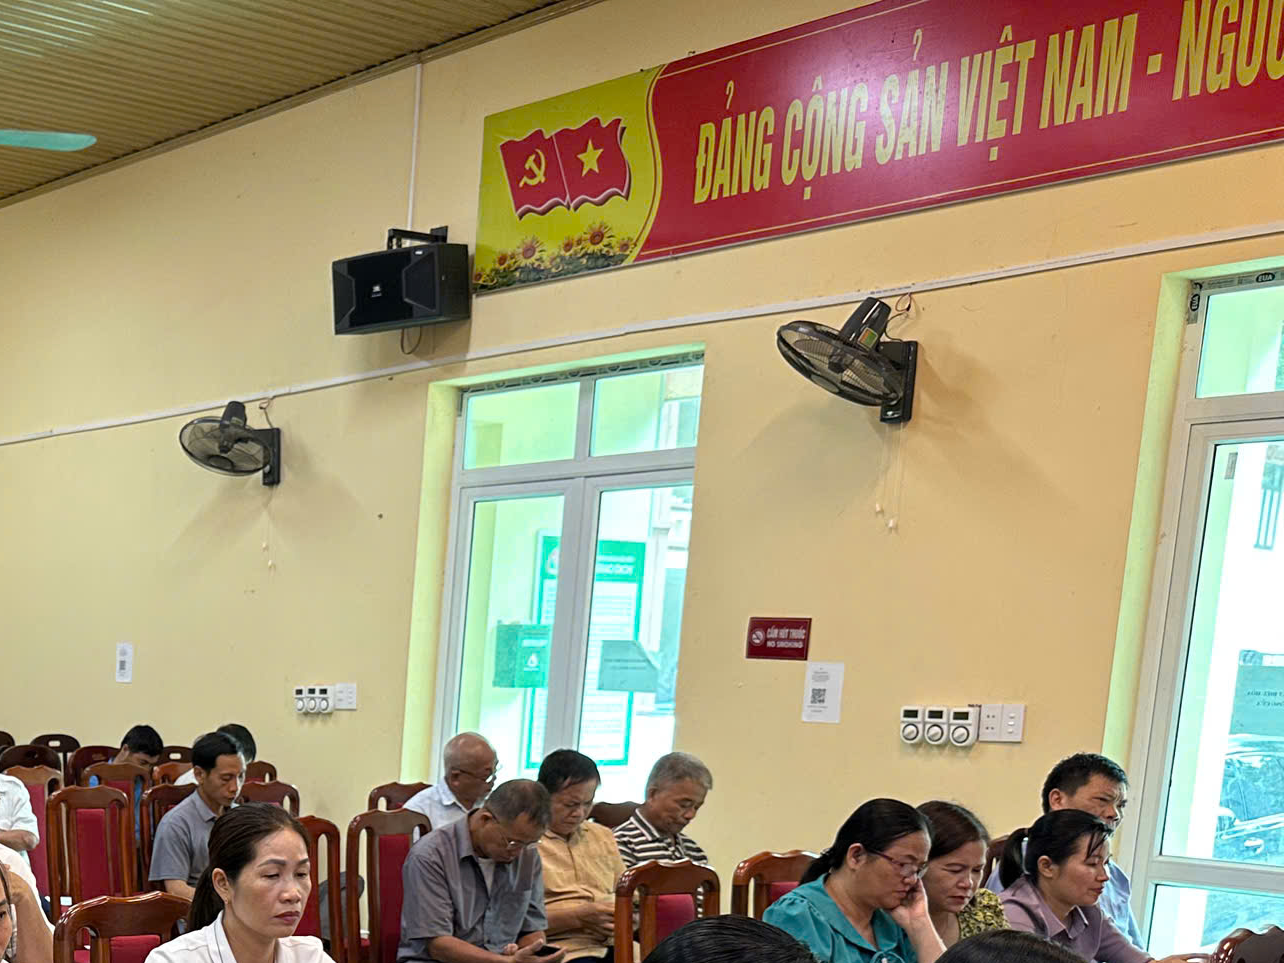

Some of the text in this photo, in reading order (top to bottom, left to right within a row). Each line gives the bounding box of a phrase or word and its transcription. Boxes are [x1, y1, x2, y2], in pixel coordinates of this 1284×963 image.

[694, 80, 775, 204] ĐẢNG
[781, 75, 868, 200] CỘNG
[875, 28, 949, 165] SẢN
[957, 24, 1036, 161] VIỆT
[1039, 13, 1138, 129] NAM
[1147, 53, 1162, 76] -
